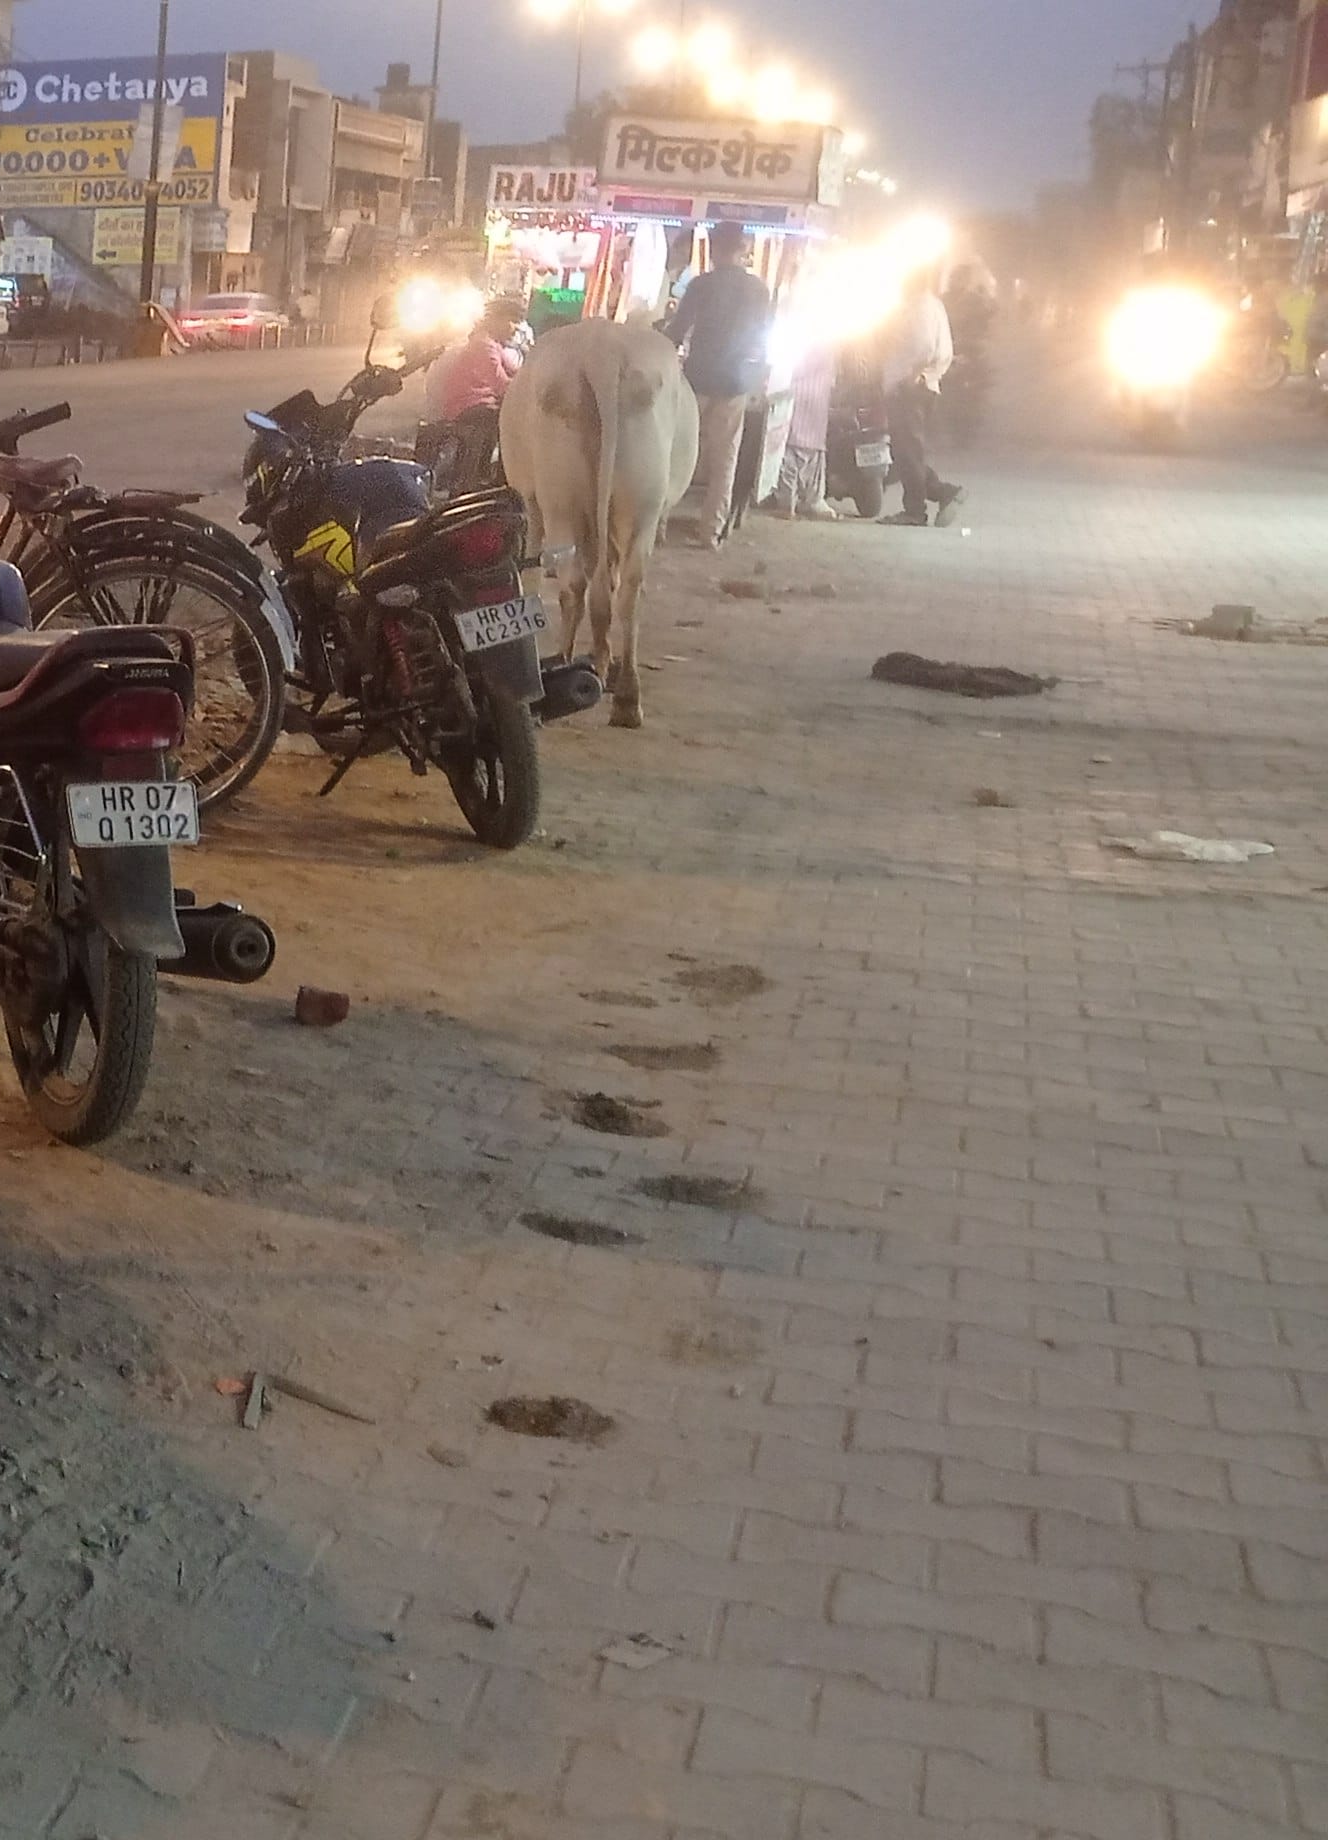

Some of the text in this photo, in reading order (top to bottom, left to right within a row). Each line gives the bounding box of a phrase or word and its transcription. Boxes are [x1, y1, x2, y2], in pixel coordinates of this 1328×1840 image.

[35, 71, 209, 105] Chetanya
[80, 179, 211, 204] 903404052
[494, 171, 576, 202] RAJU
[476, 599, 526, 626] HR 07
[475, 613, 546, 647] AC2316
[101, 785, 177, 812] HR 07
[124, 814, 189, 840] 1302
